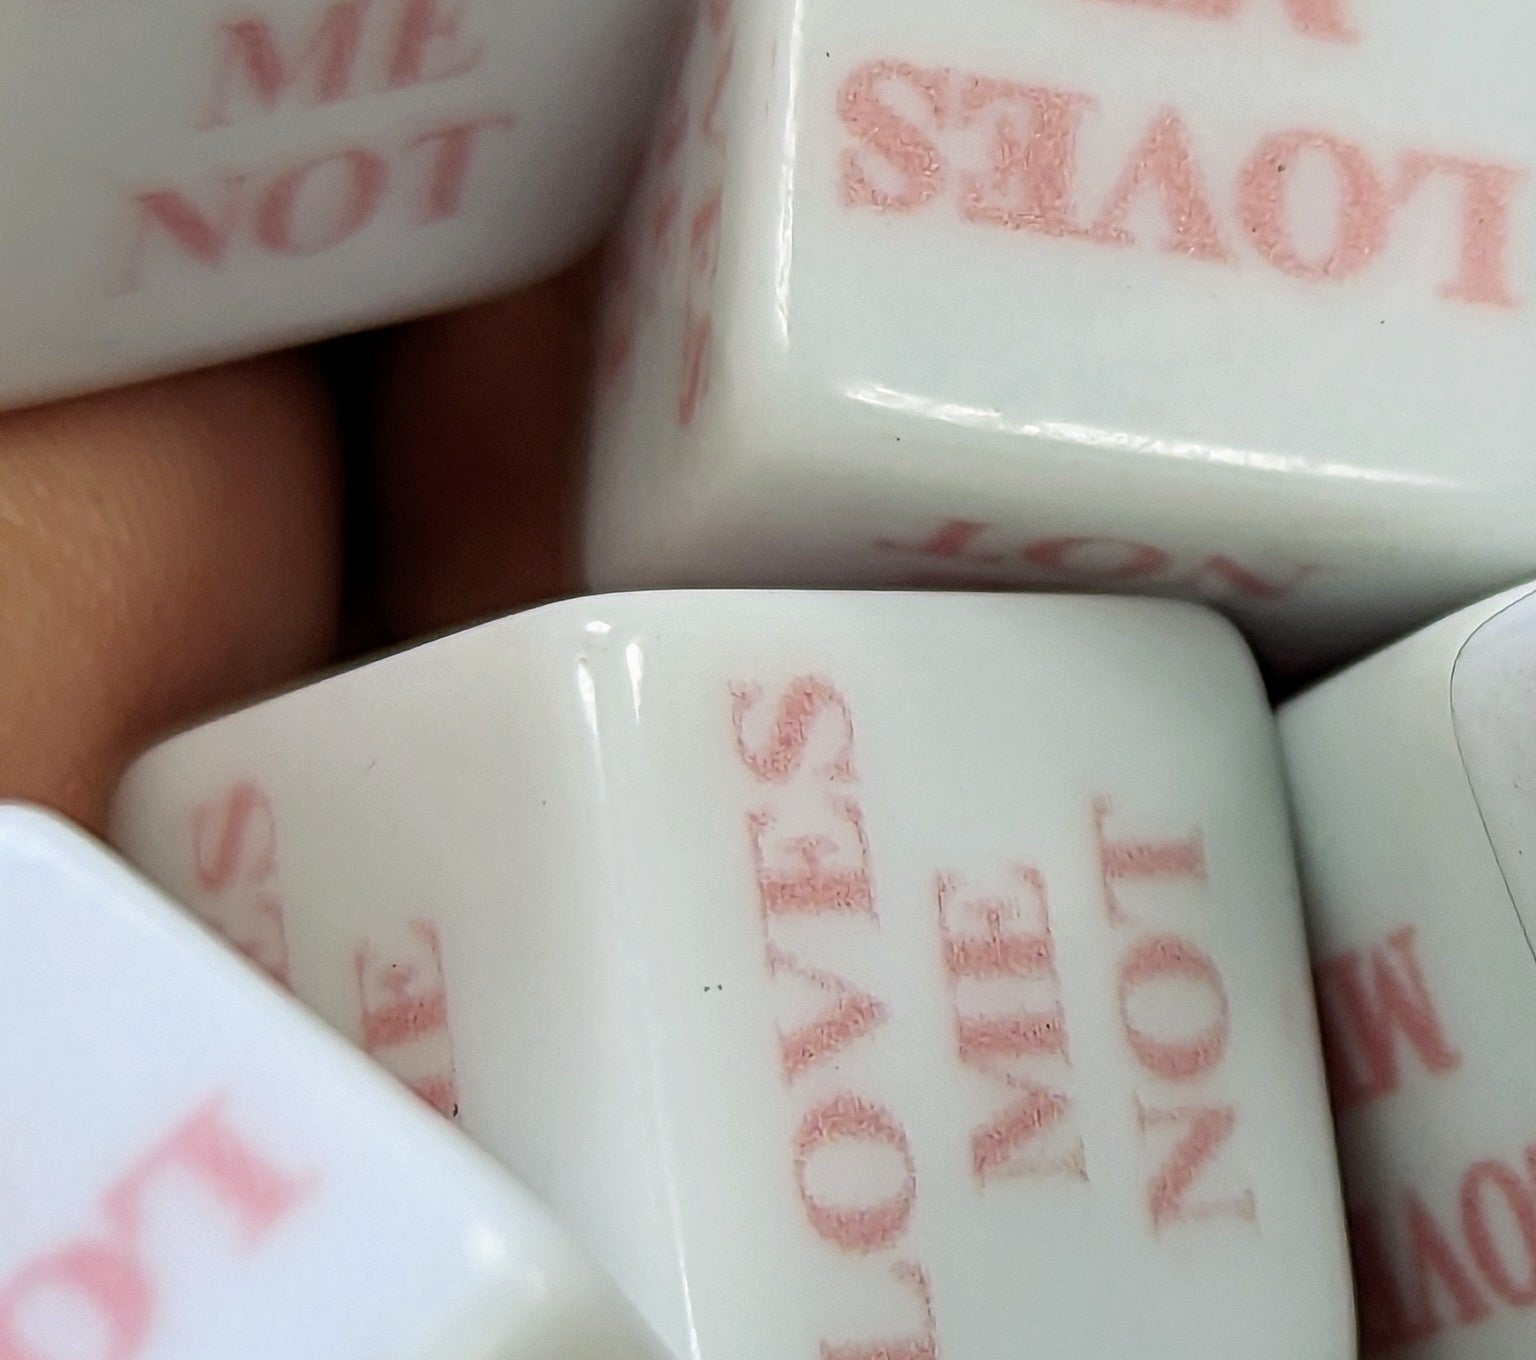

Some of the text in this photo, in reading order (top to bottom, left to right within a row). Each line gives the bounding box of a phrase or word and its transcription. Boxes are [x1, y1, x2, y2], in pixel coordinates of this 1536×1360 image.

[107, 113, 520, 296] NOT
[833, 56, 1529, 310] LOVES
[933, 857, 1090, 1190] ME
[1090, 791, 1260, 1241] NOT
